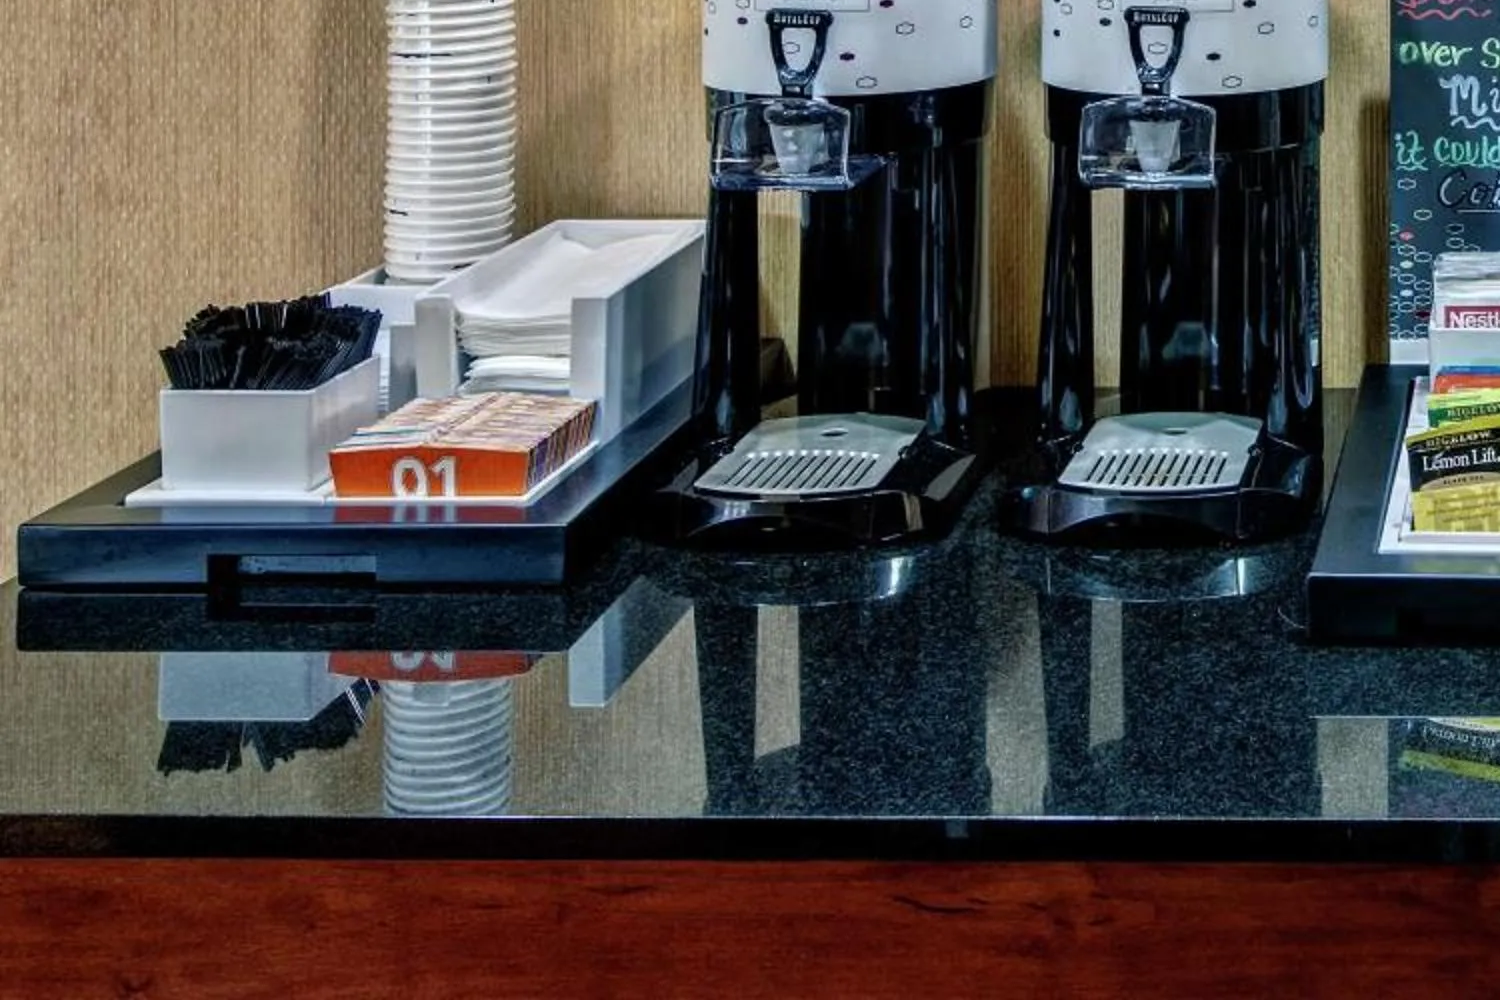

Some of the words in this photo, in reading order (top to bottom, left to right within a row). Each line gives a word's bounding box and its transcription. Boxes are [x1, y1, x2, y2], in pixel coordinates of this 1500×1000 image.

[1399, 41, 1473, 67] over
[1395, 131, 1427, 166] it
[392, 456, 457, 498] 01
[1423, 454, 1470, 471] Lemon
